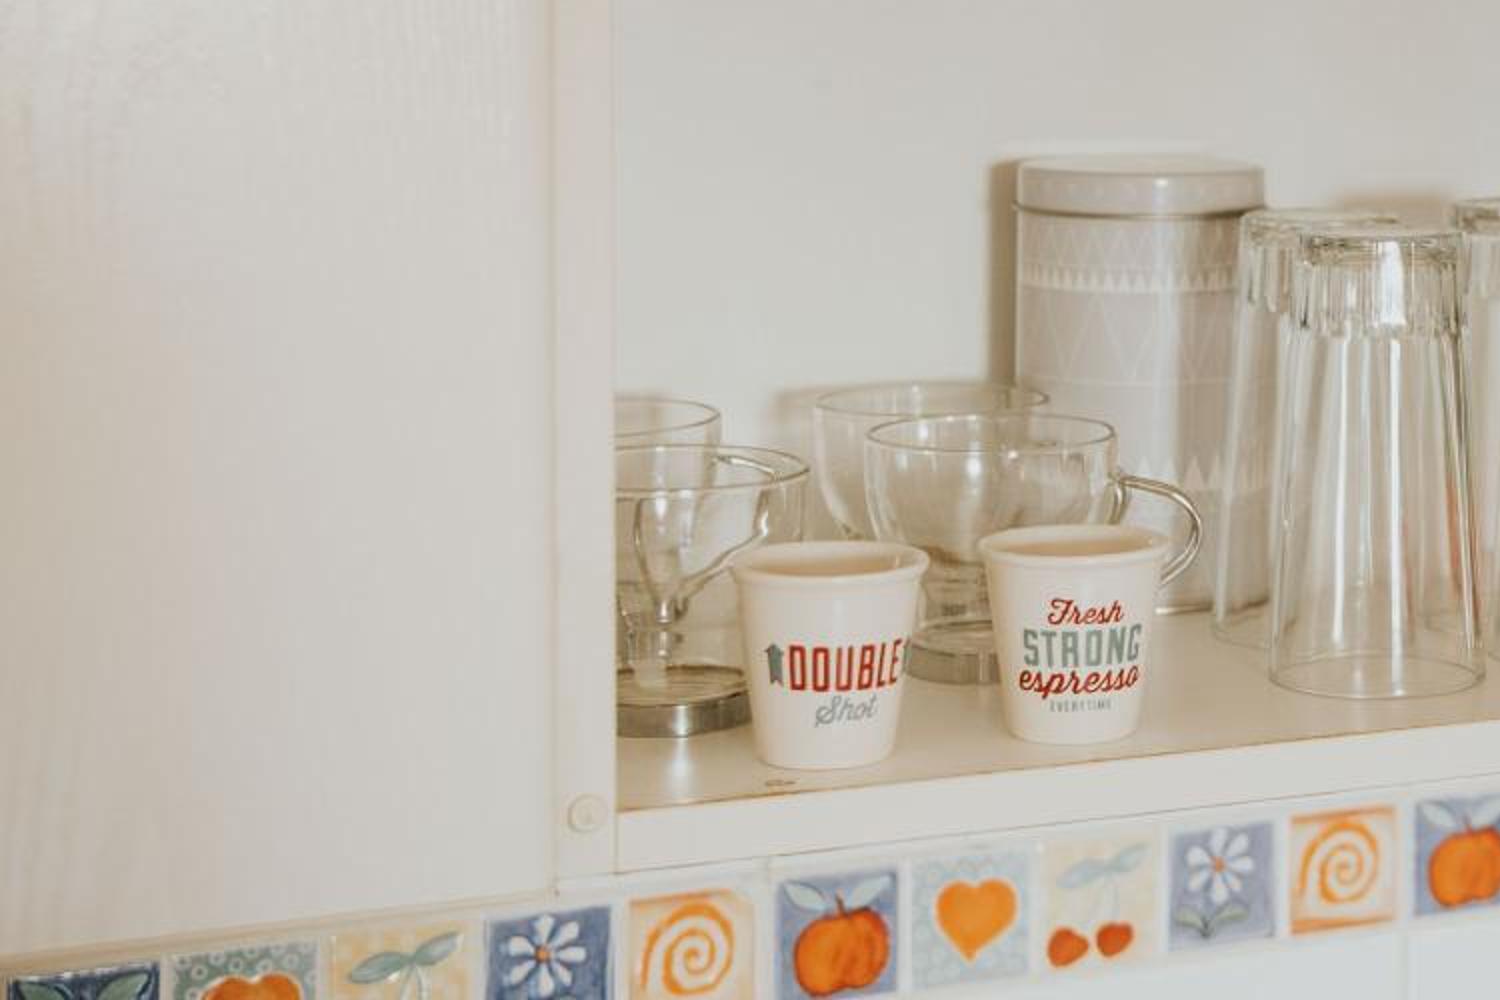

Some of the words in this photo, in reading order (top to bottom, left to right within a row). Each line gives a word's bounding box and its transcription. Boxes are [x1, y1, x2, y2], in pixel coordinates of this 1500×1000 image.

[1047, 598, 1124, 625] Fresh
[1023, 624, 1142, 667] STRONG
[789, 638, 903, 692] DOUBLE
[1019, 665, 1138, 700] espresso
[815, 695, 878, 728] Shot
